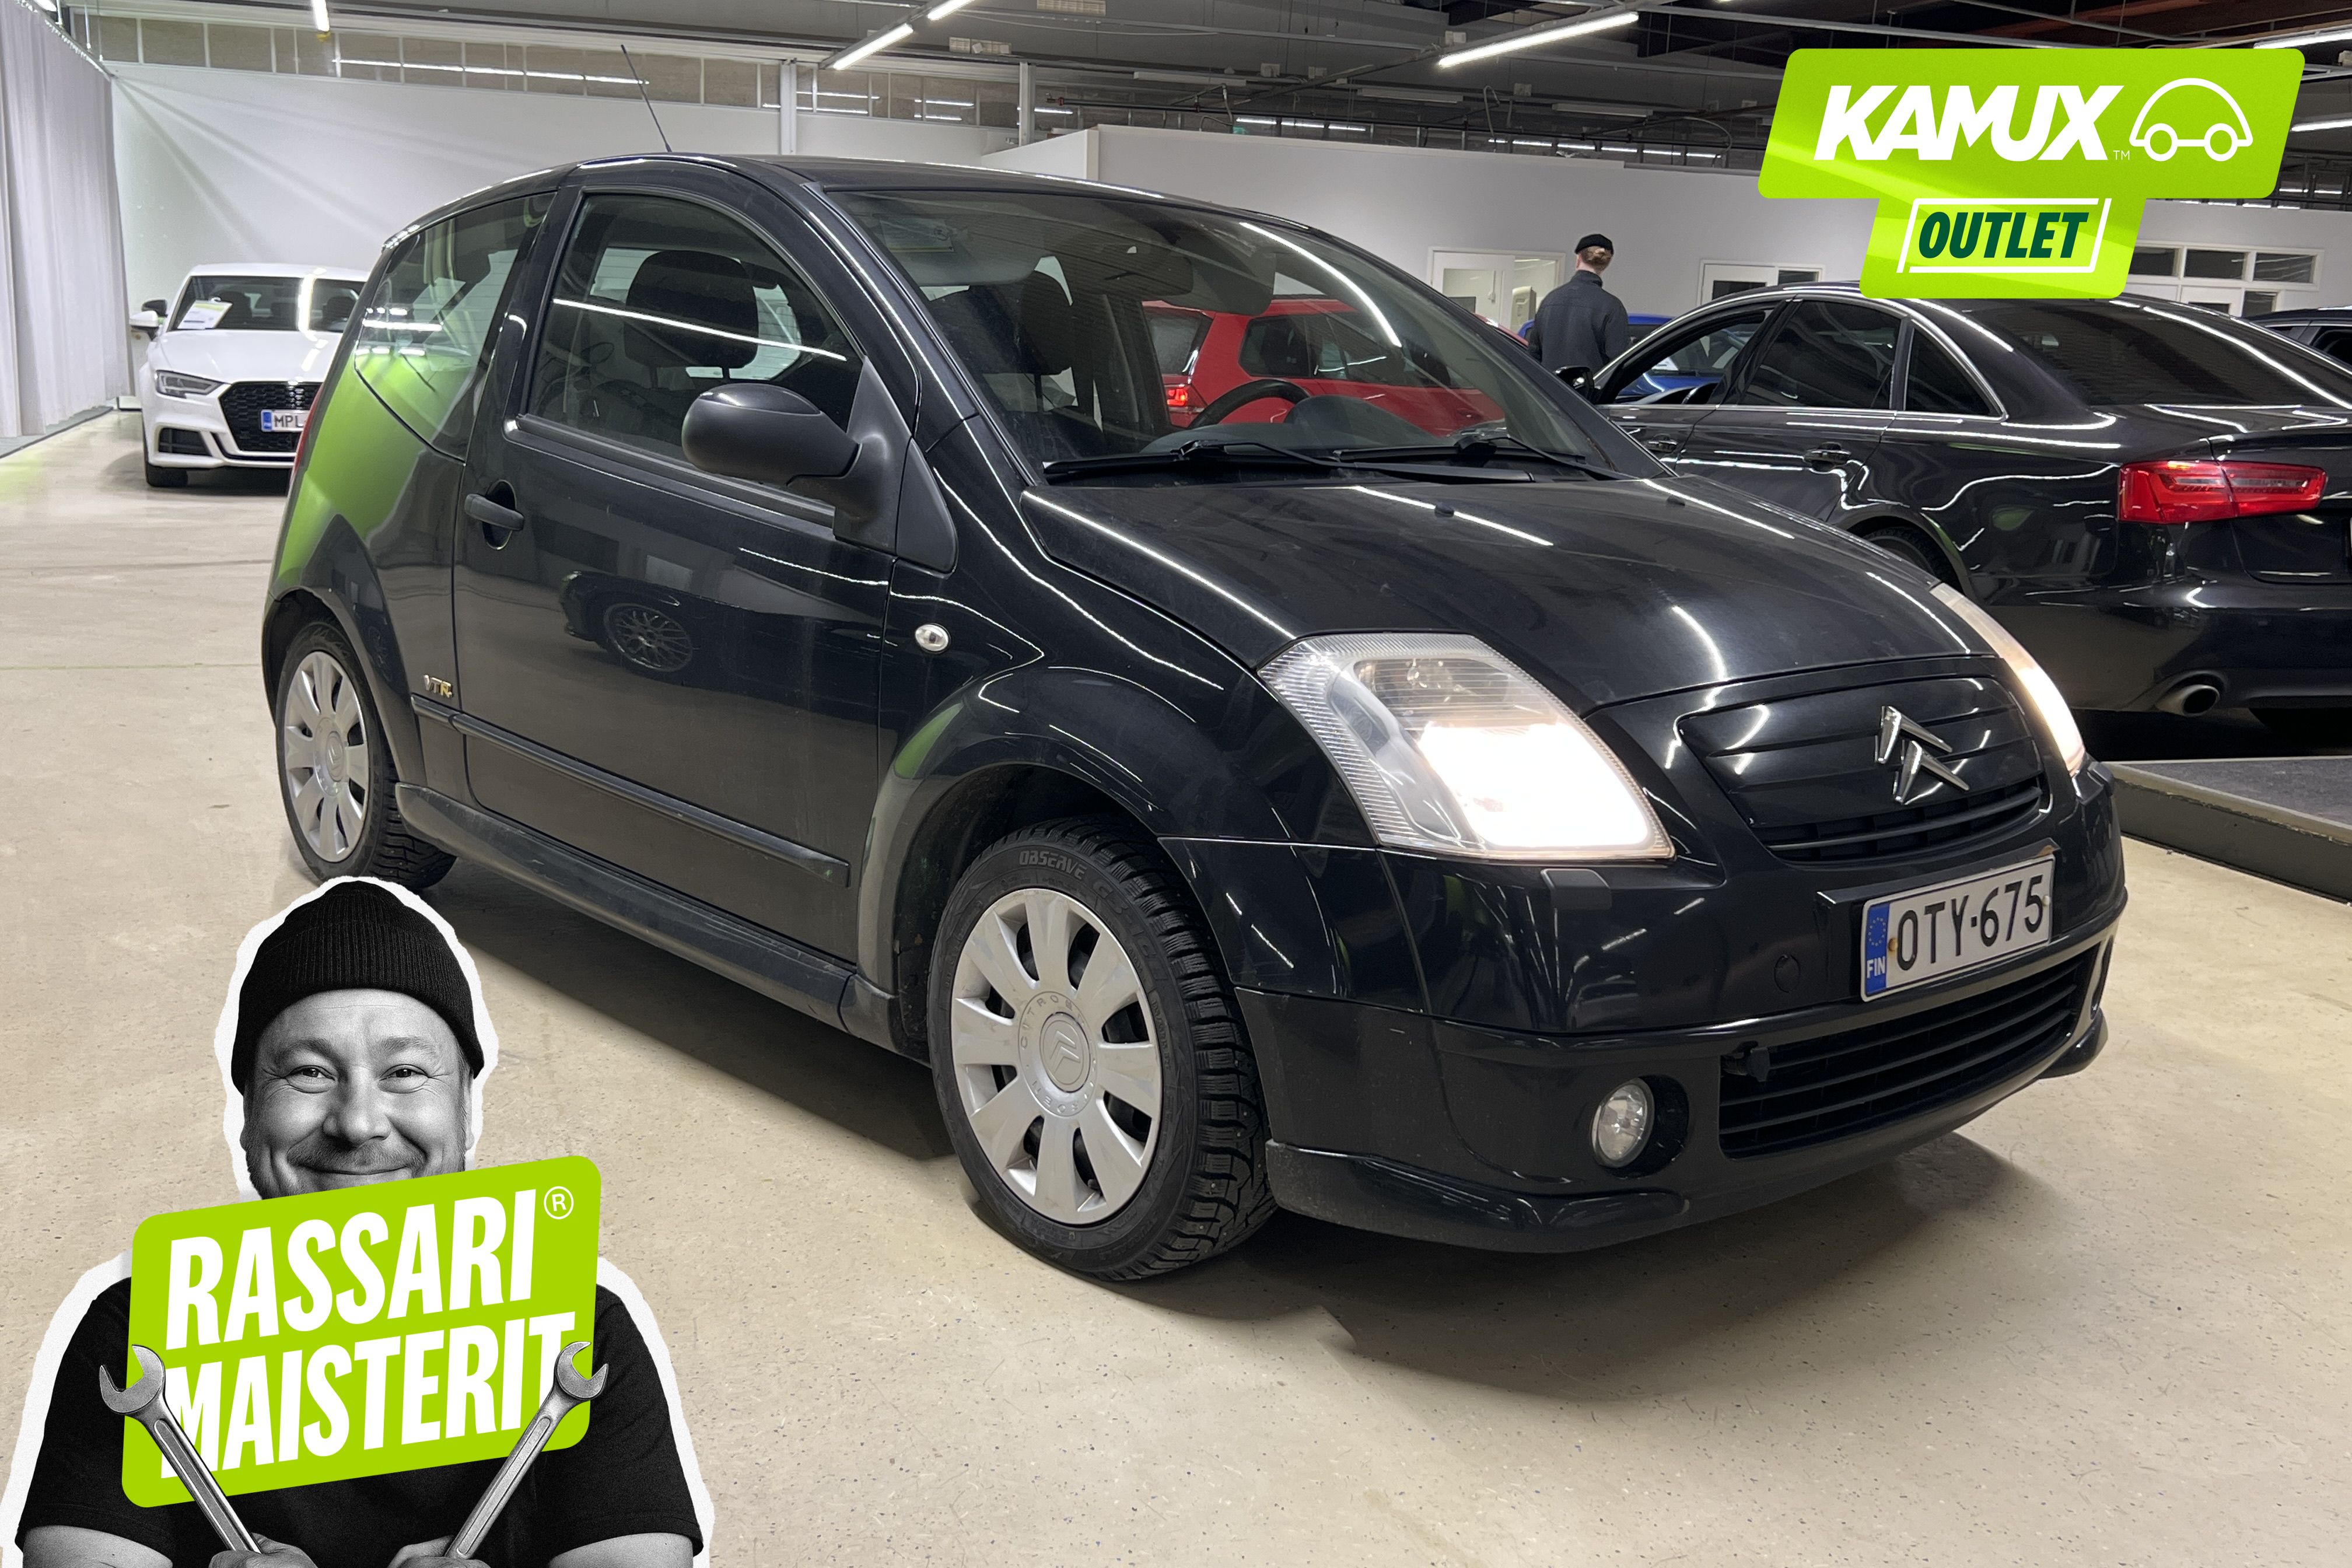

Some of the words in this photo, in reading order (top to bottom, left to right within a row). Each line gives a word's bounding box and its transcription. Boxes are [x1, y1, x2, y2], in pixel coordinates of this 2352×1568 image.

[274, 415, 306, 428] MPL
[1019, 849, 1088, 881] OBSERVE
[1896, 874, 2045, 971] OTY-675
[1867, 956, 1886, 979] FIN
